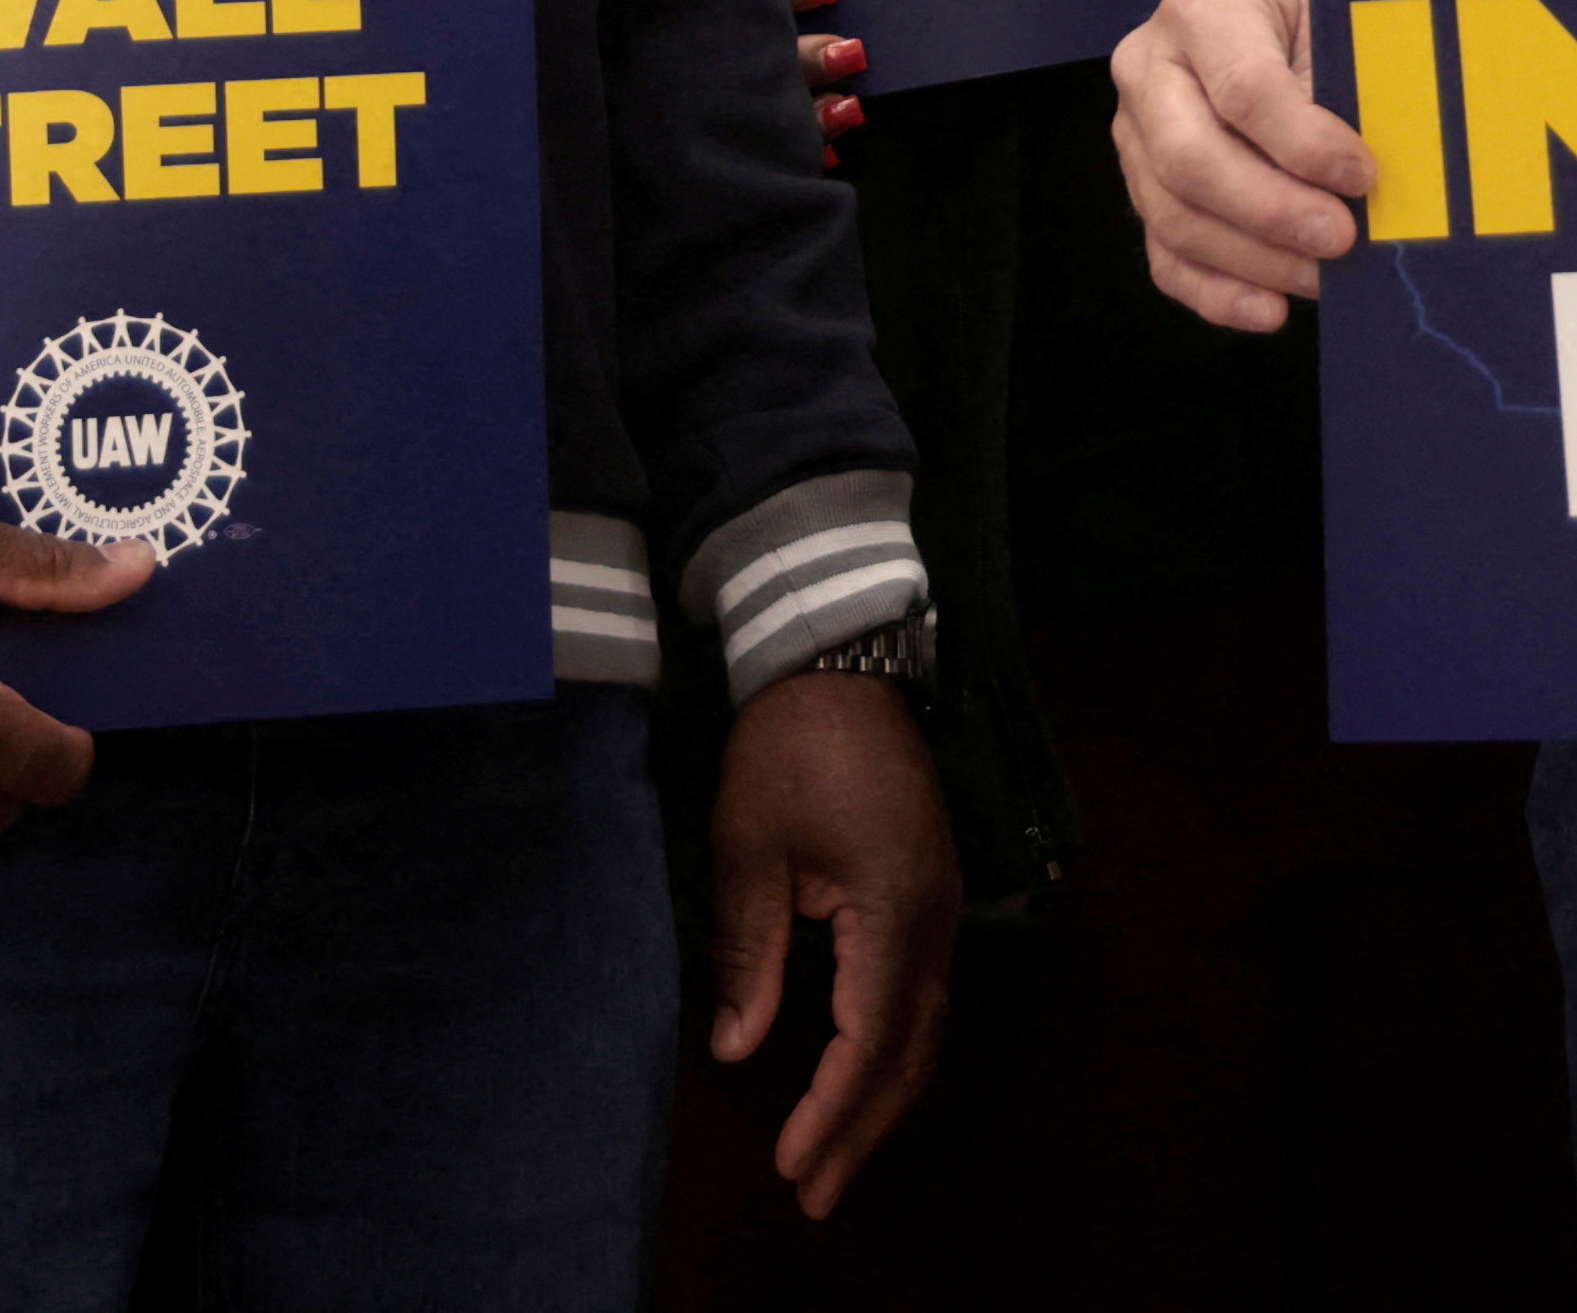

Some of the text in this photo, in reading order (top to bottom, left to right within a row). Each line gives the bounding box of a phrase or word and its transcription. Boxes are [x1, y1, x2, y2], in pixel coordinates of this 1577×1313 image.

[72, 355, 123, 381] AMERICA
[124, 353, 166, 373] UNITED
[38, 393, 64, 445] WORKERS
[71, 412, 173, 471] UAW
